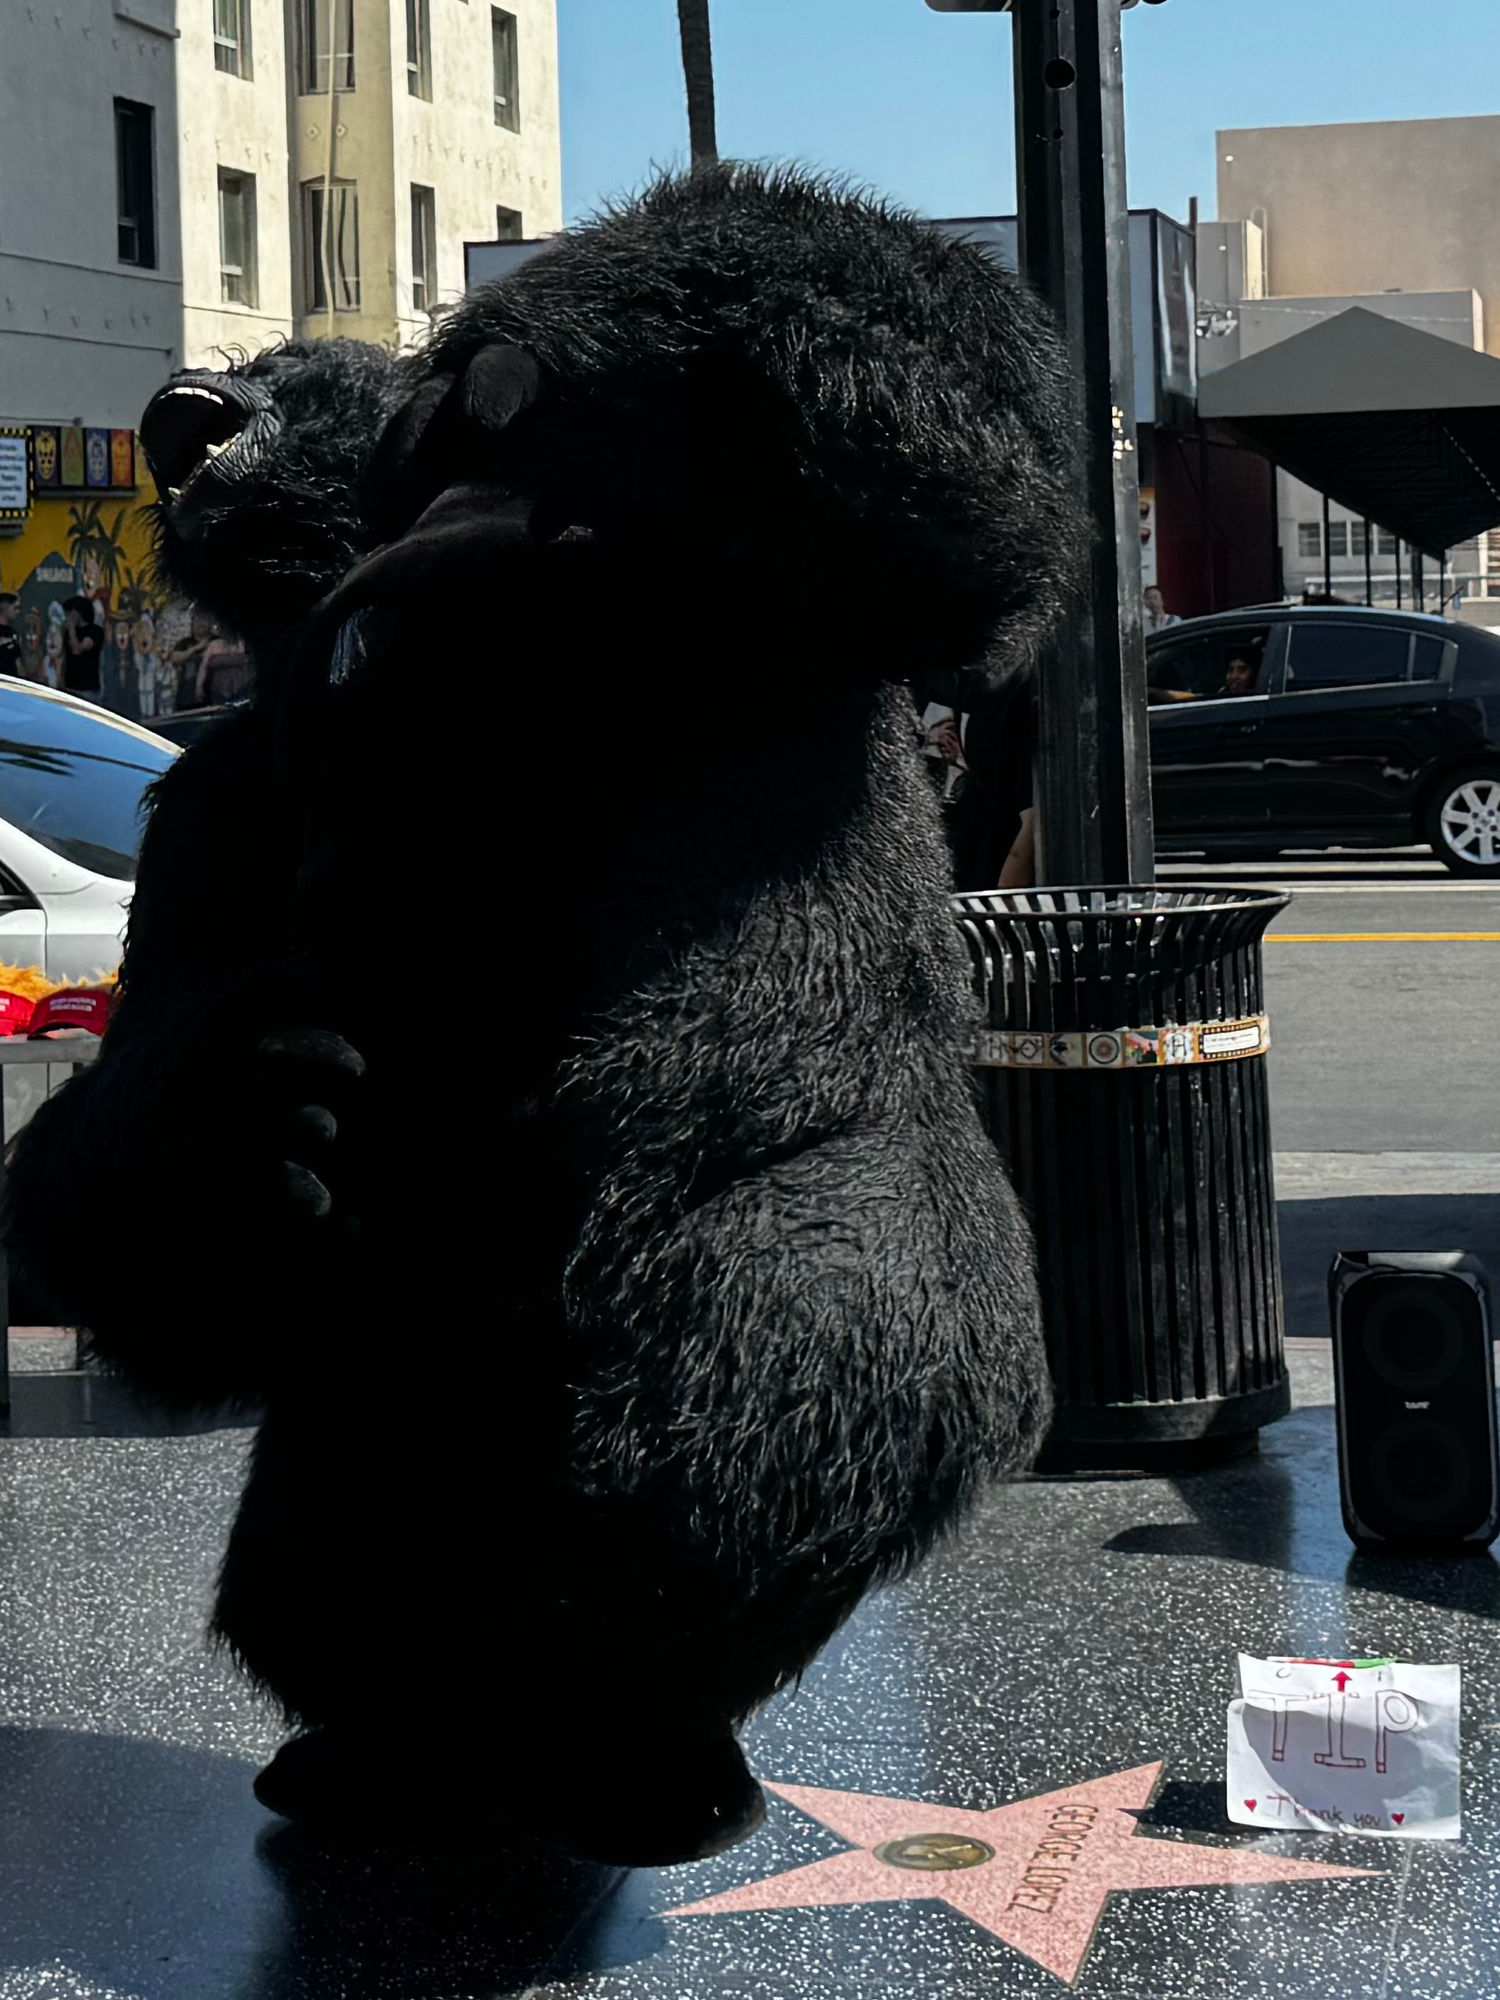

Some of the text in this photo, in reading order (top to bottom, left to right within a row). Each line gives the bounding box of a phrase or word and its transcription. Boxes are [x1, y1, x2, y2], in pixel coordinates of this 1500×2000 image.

[1247, 1689, 1420, 1773] TIP
[1005, 1804, 1099, 1914] GEORGE LOPEZ
[1353, 1812, 1382, 1829] you
